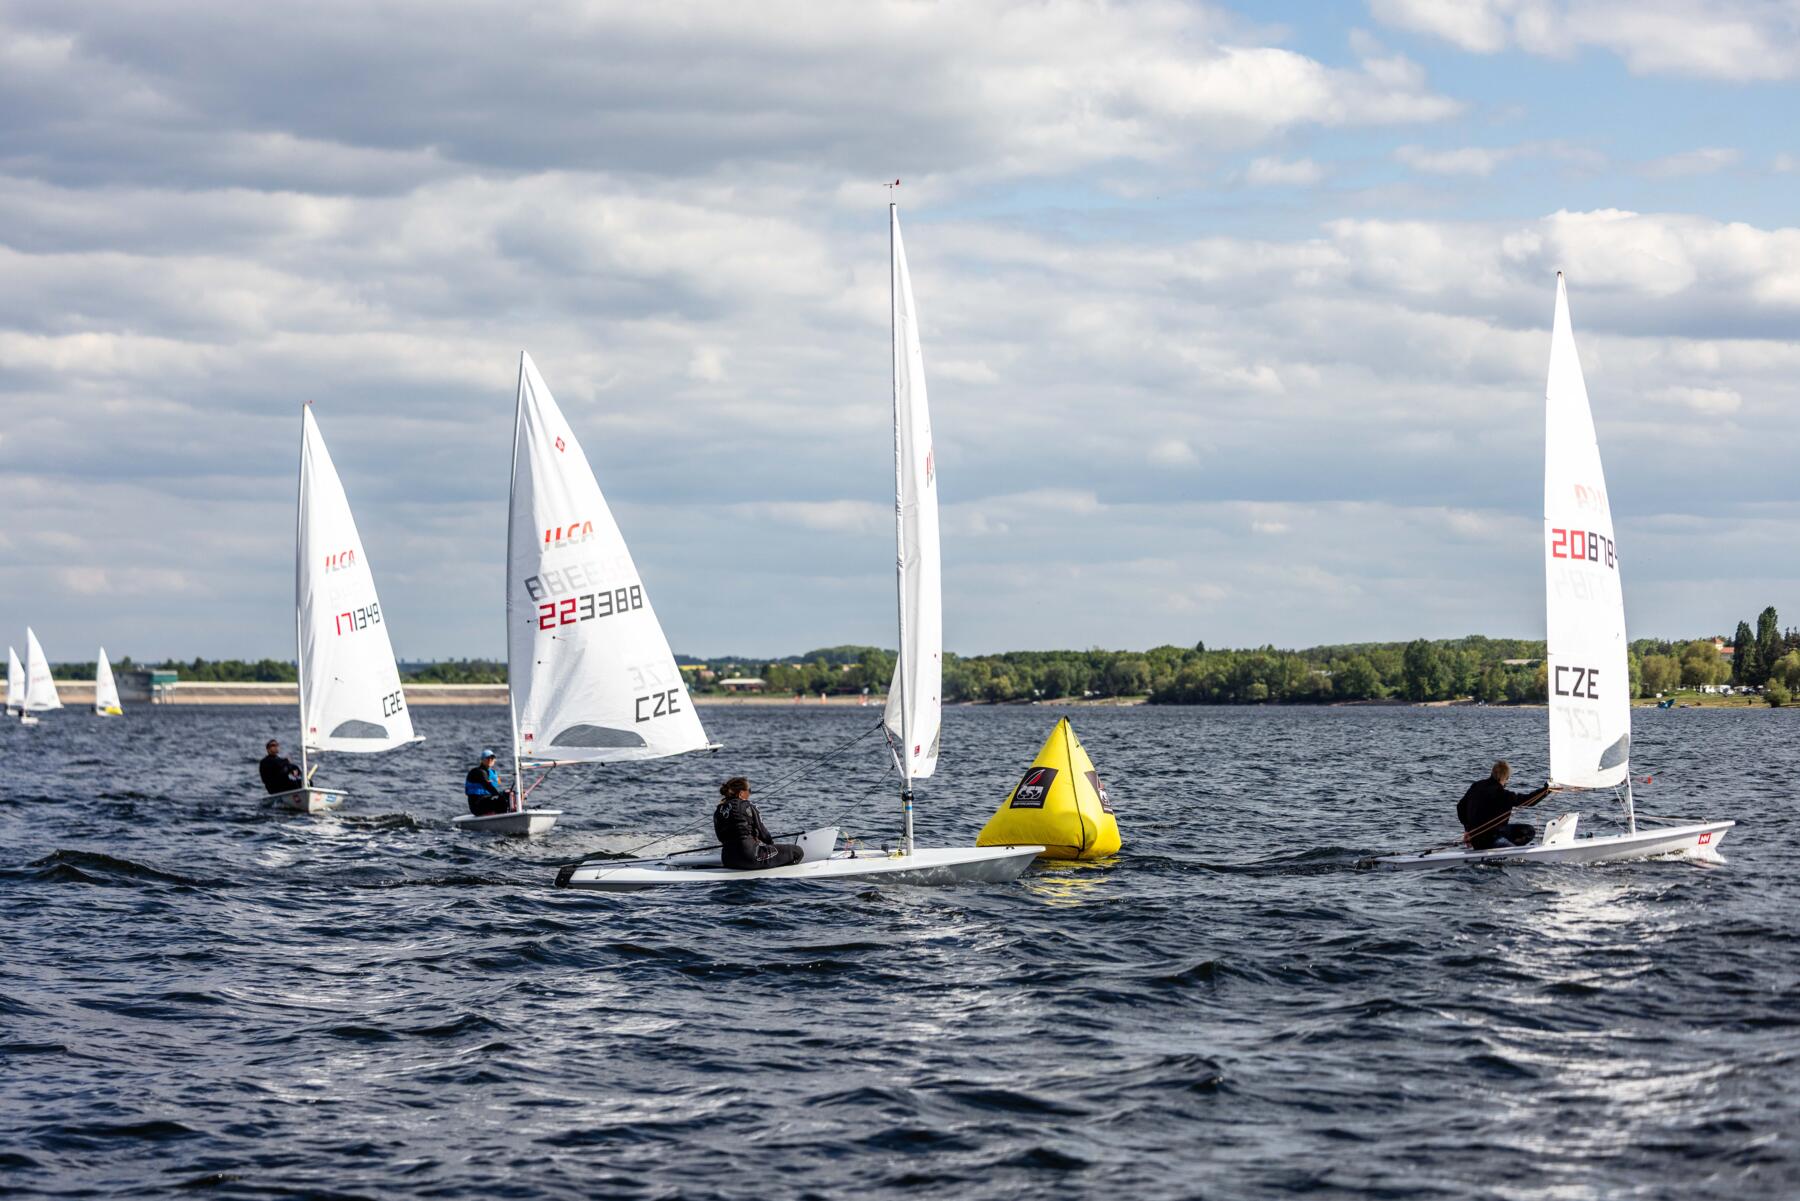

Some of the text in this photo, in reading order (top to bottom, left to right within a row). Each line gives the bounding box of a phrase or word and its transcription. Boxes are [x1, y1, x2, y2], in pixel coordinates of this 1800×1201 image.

[544, 520, 596, 551] ILCA
[1552, 528, 1618, 570] 20878
[325, 549, 357, 574] ILCA
[335, 602, 381, 636] 171349
[539, 584, 643, 631] 223388
[1555, 665, 1600, 700] CZE
[382, 690, 403, 718] CZE
[635, 688, 681, 723] CZE
